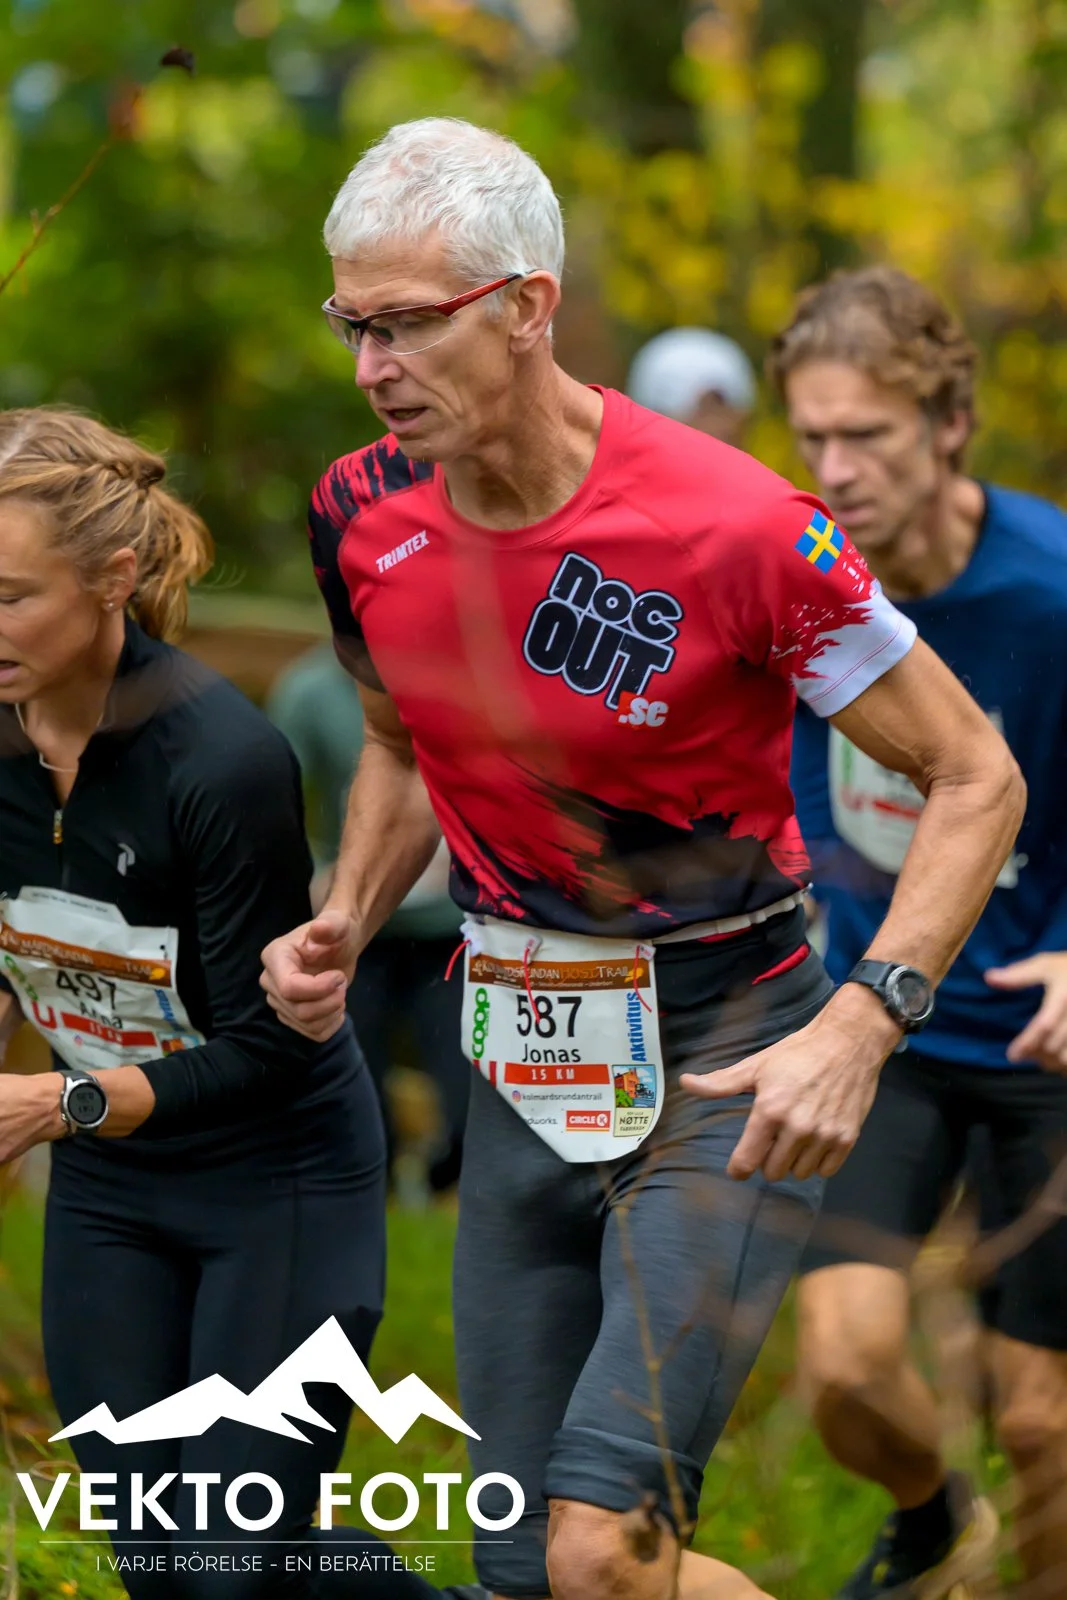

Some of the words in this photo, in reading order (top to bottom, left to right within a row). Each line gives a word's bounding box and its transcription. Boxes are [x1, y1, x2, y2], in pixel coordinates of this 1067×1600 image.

[376, 530, 430, 574] TRIMTEX
[522, 598, 676, 711] OUT
[56, 969, 117, 1010] 497
[472, 987, 490, 1059] coop
[516, 994, 582, 1039] 587
[626, 991, 647, 1062] Aktivitus
[521, 1043, 581, 1063] Jonas
[531, 1068, 548, 1081] 15
[556, 1067, 575, 1081] KM
[569, 1115, 596, 1125] CIRCLE
